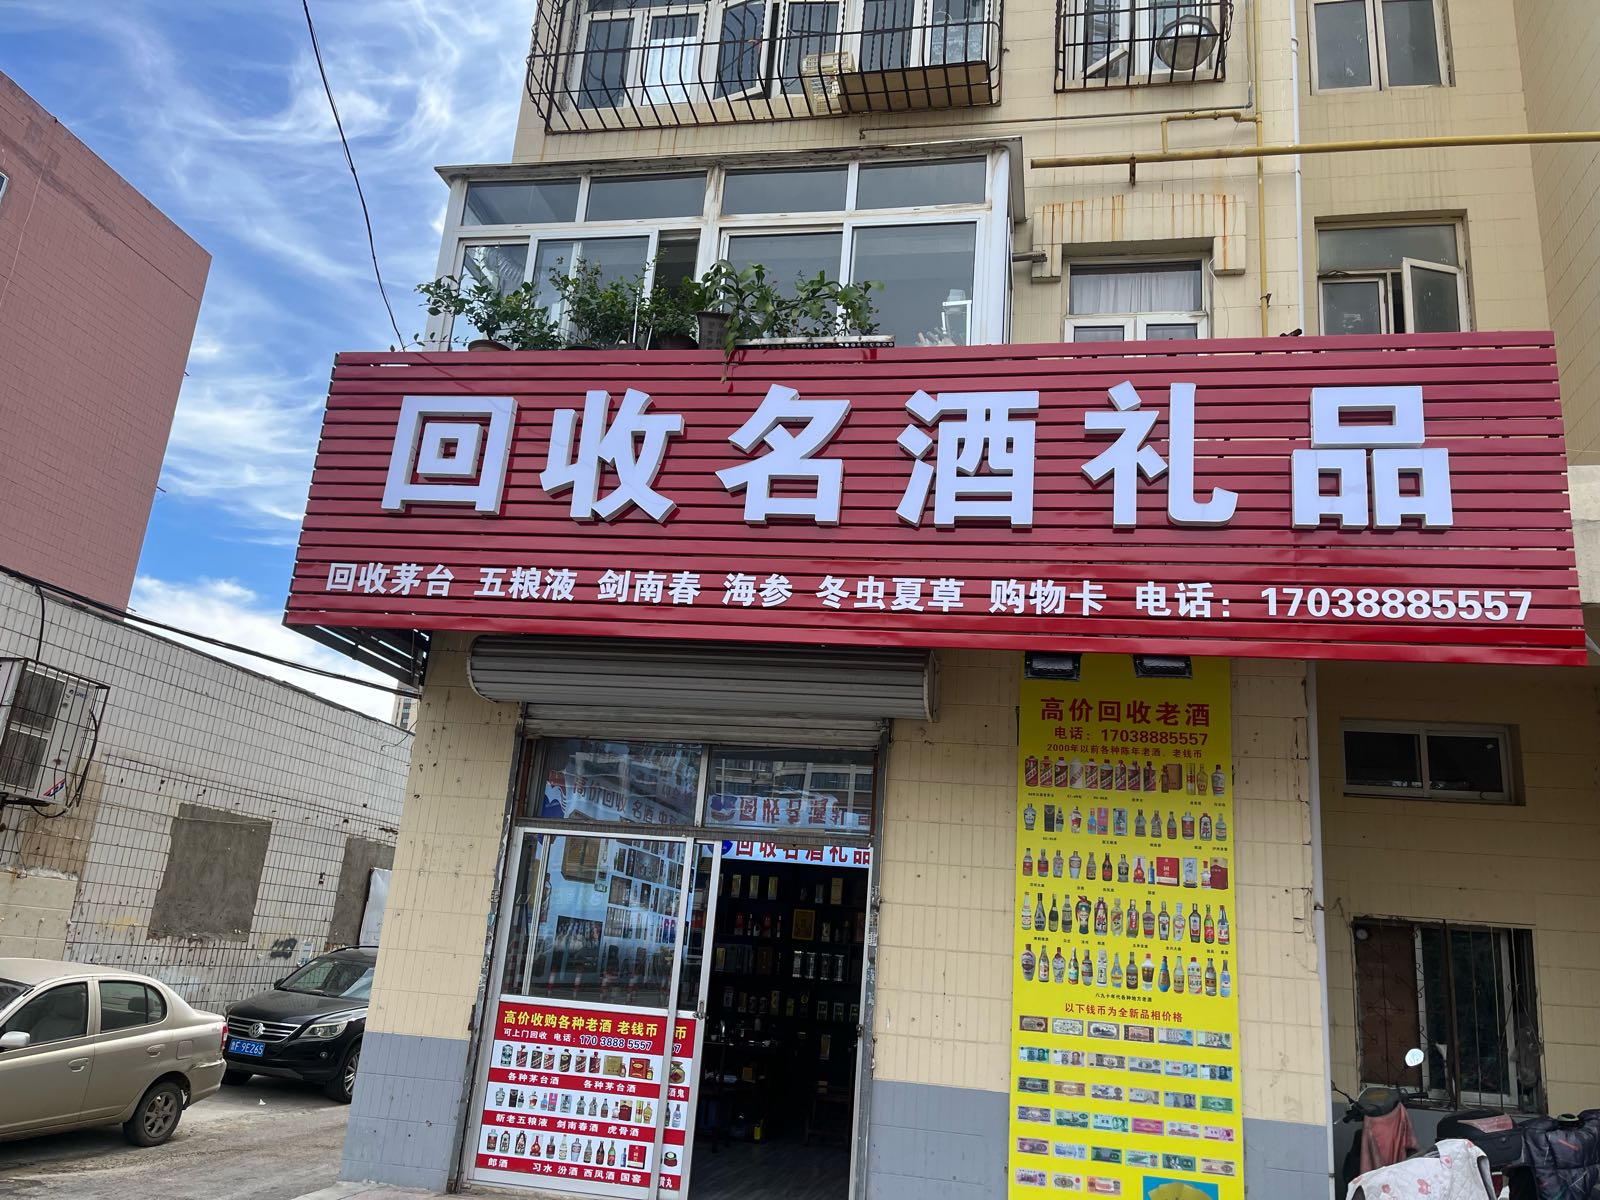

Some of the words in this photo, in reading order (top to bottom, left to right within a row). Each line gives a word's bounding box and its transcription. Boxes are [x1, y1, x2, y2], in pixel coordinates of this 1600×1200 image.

[381, 380, 1454, 529] 回收名酒礼品
[325, 563, 455, 598] 回收茅台
[474, 567, 578, 602] 五粮液
[597, 569, 701, 604] 剑南春
[722, 573, 793, 608] 海参
[815, 574, 964, 613] 冬虫夏草
[989, 580, 1107, 616] 购物卡
[1261, 587, 1533, 621] 17038885557
[1041, 697, 1209, 727] 高价回收老酒
[1101, 729, 1207, 745] 17038885557
[504, 1010, 612, 1033] 高价收购各种老酒
[617, 1021, 658, 1037] 老钱币
[1065, 1002, 1183, 1022] 以下钱币为全新品相价格
[504, 1028, 547, 1040] 可上门回收
[675, 1026, 687, 1040] 币
[508, 1072, 560, 1085] 各种茅台酒
[583, 1079, 637, 1093] 各种茅台酒
[495, 1113, 548, 1127] 新老五粮液
[556, 1119, 599, 1132] 剑南春酒
[607, 1125, 640, 1137] 虎骨酒
[488, 1157, 509, 1168] 郎酒
[533, 1162, 553, 1173] 习水
[557, 1165, 578, 1176] 汾酒
[584, 1168, 615, 1180] 西凤酒
